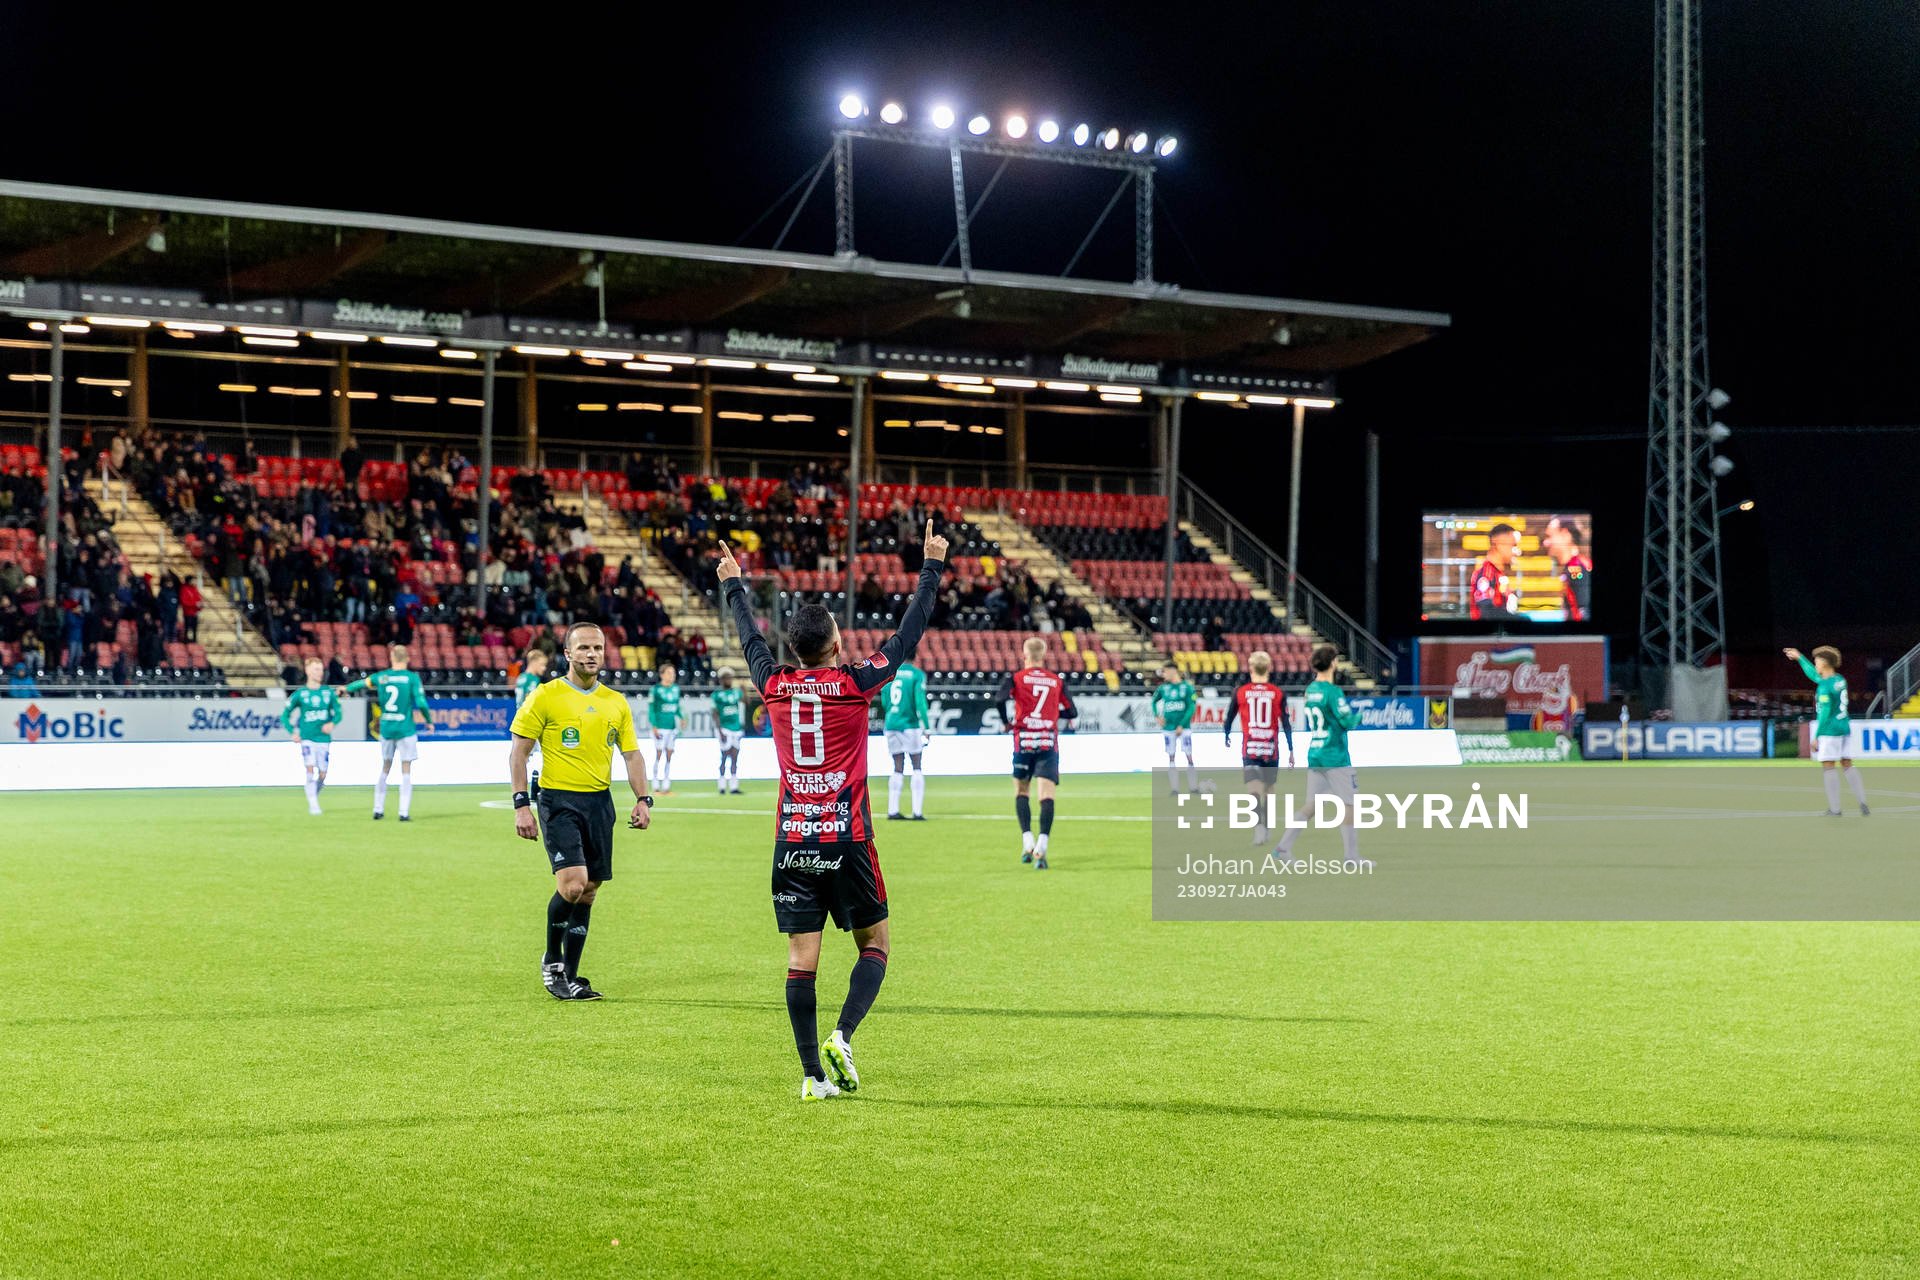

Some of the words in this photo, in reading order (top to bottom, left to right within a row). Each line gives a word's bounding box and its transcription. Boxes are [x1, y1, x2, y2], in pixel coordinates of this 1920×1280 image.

[385, 685, 398, 712] 2
[890, 680, 903, 705] 6
[1031, 685, 1050, 718] 7
[18, 708, 124, 739] MoBic
[188, 707, 284, 737] Bilbolage
[1247, 697, 1272, 729] 10
[791, 693, 825, 766] 8
[1587, 726, 1763, 754] POLARIS
[785, 769, 824, 784] ÖSTER
[793, 783, 829, 794] SUND
[782, 819, 848, 836] engcon
[777, 850, 843, 870] Norrland
